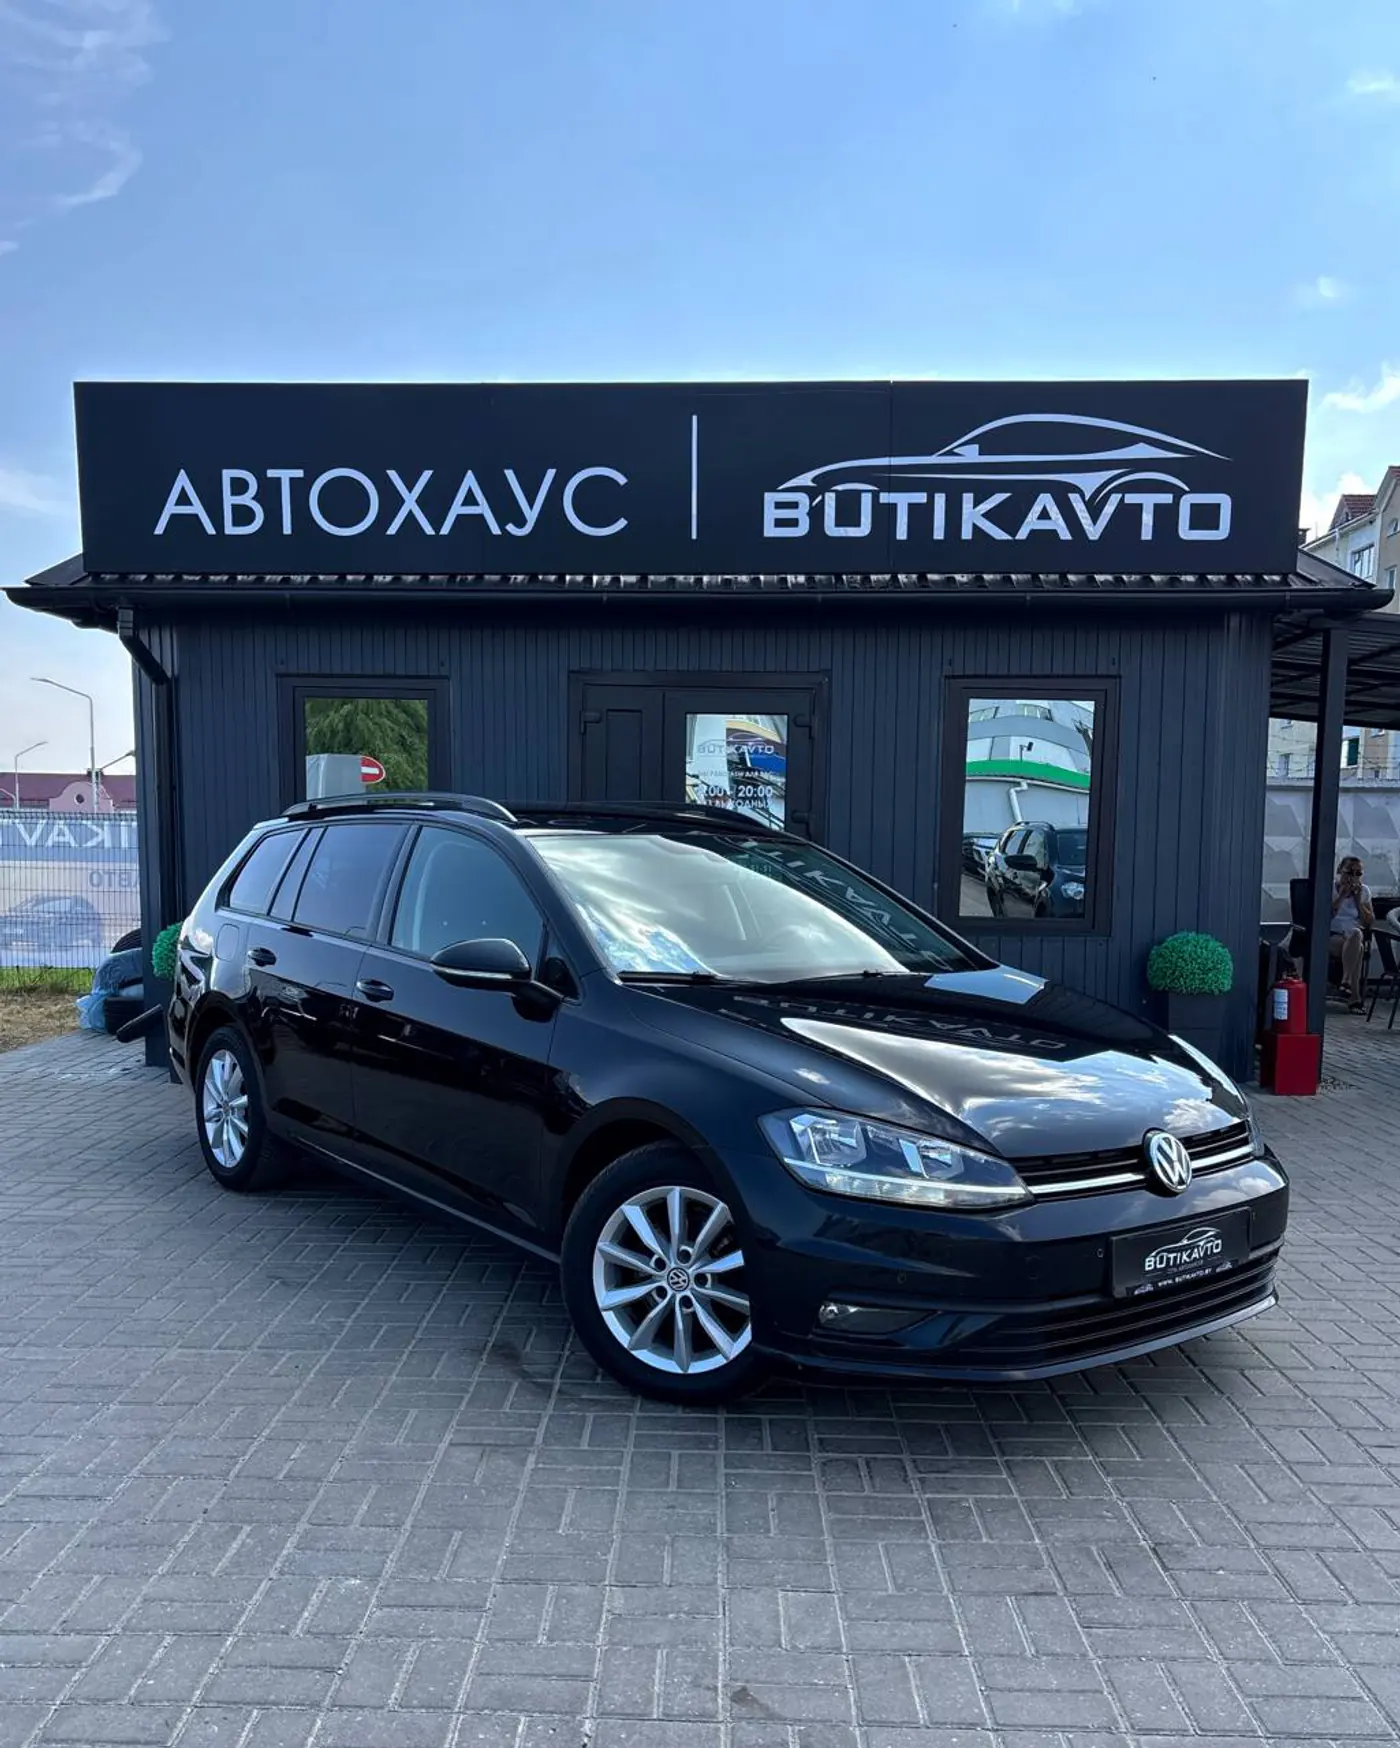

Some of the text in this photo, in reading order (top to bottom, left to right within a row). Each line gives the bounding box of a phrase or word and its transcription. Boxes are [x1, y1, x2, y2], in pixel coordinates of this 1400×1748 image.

[153, 467, 629, 537] АВТОХАУС
[763, 491, 1232, 541] BUTIKAVTO
[737, 785, 774, 798] 20:00
[1145, 1239, 1222, 1271] BUTIKAVTO
